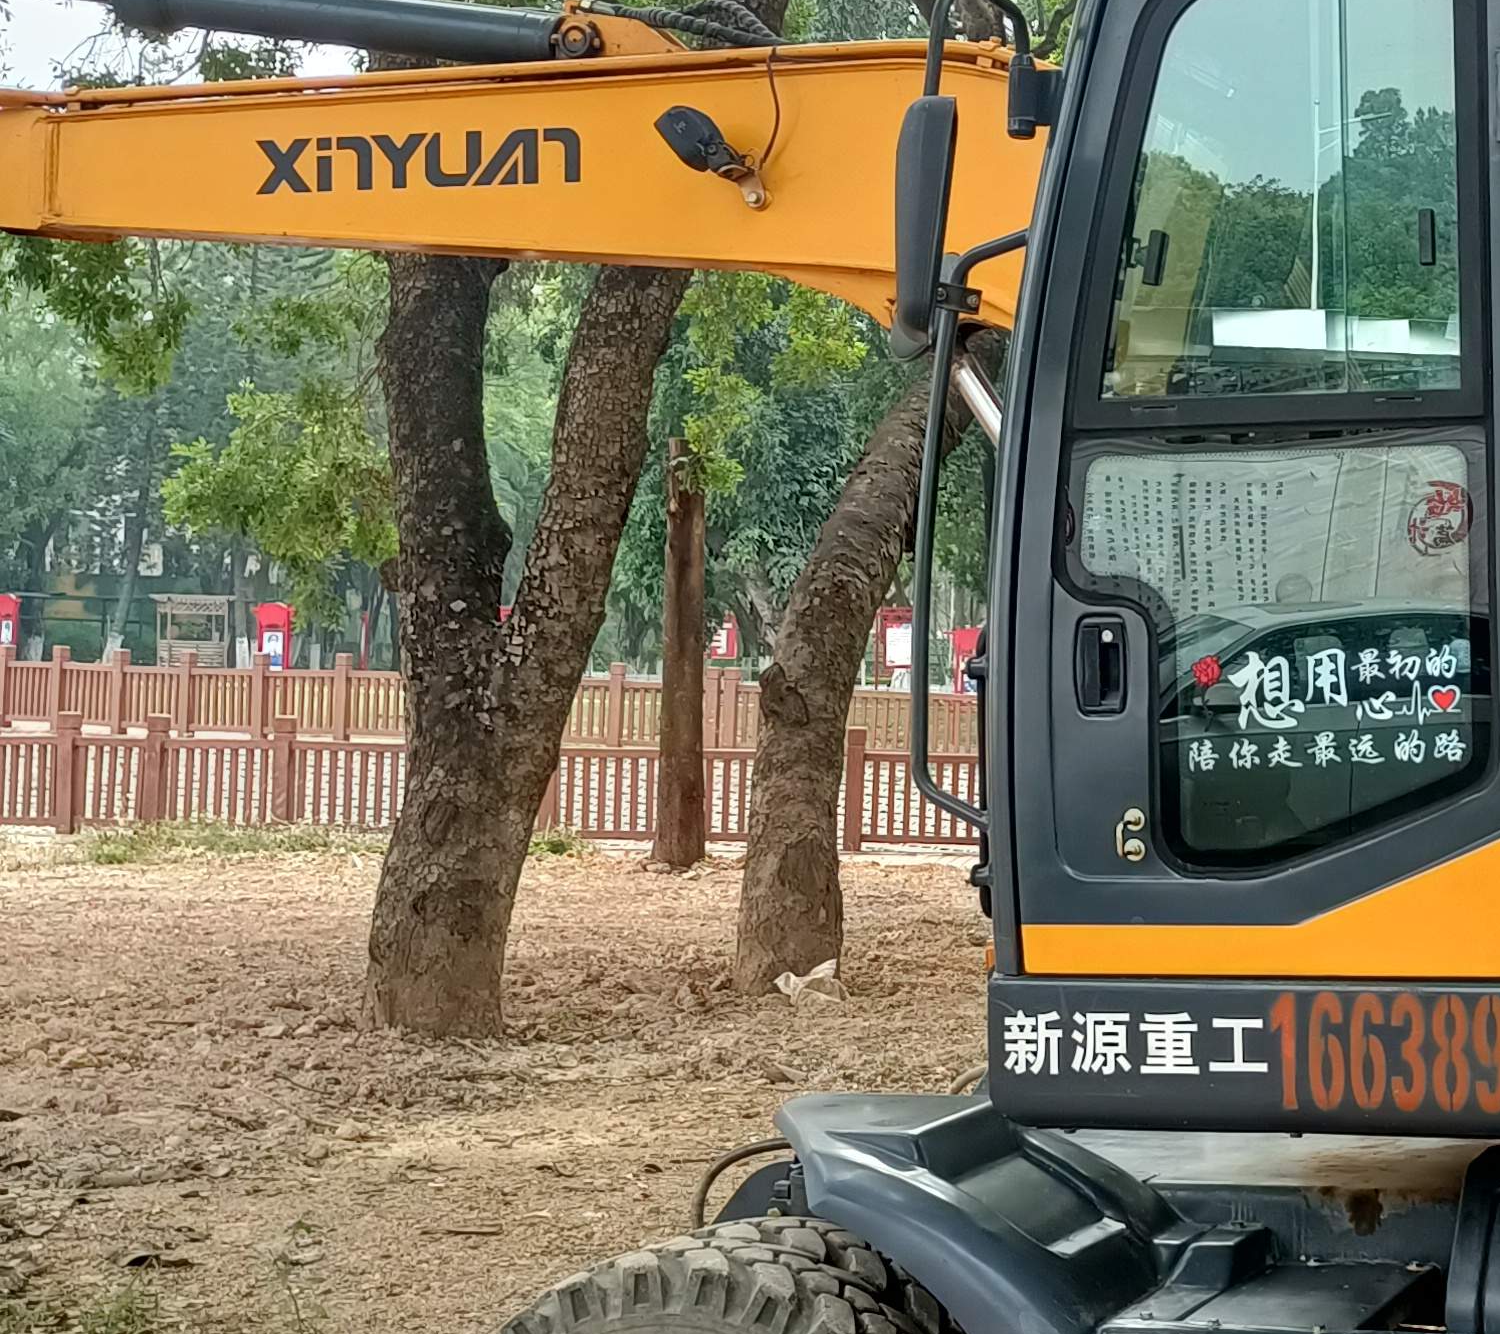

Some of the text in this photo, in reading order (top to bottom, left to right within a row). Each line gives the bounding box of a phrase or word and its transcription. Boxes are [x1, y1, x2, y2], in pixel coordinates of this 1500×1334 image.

[1351, 644, 1458, 685] 最初的
[1228, 648, 1349, 730] 想用
[1356, 691, 1397, 721] 心
[1188, 728, 1467, 772] 陪你走最远的路
[1003, 1009, 1269, 1075] 新源重工
